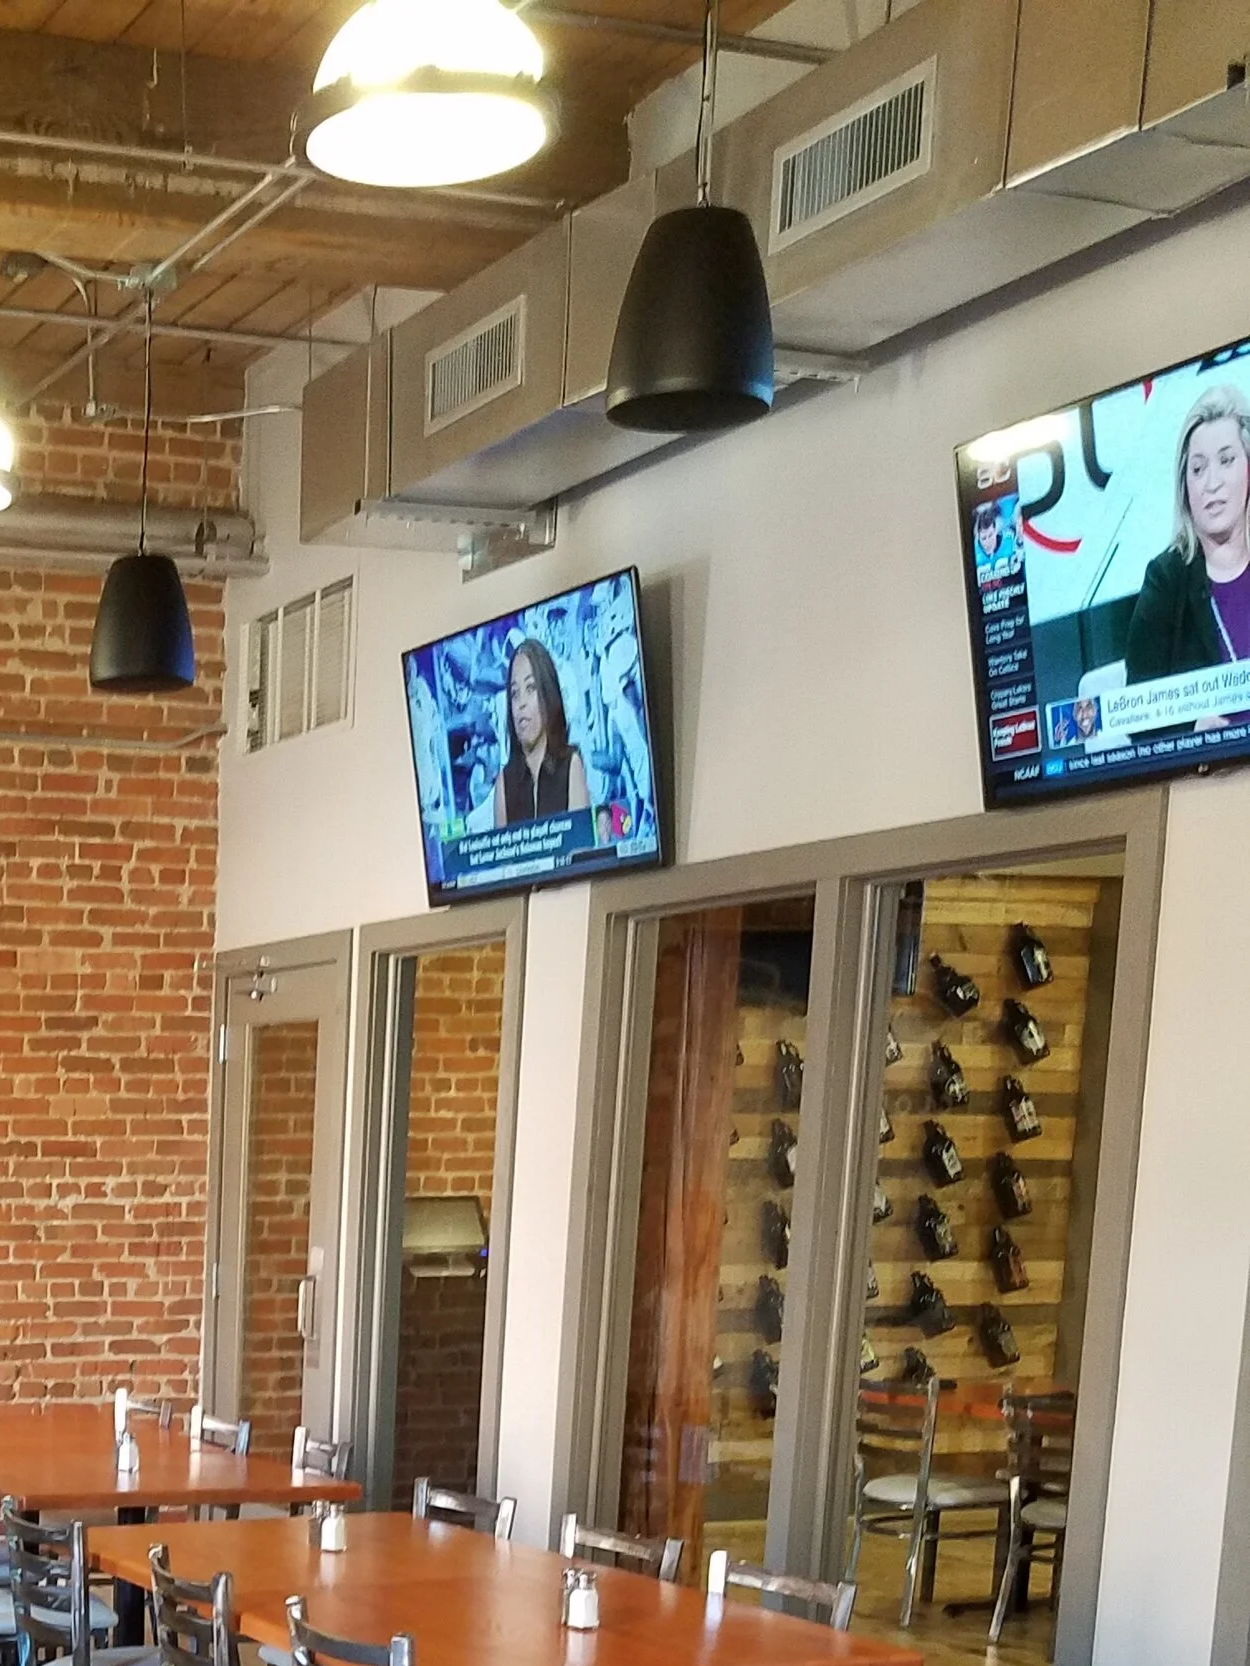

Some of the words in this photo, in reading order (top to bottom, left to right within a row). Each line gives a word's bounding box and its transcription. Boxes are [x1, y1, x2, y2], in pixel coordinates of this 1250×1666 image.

[1107, 693, 1143, 713] LeBron
[1146, 687, 1180, 706] James
[1183, 680, 1199, 697] sat
[1201, 675, 1220, 694] out
